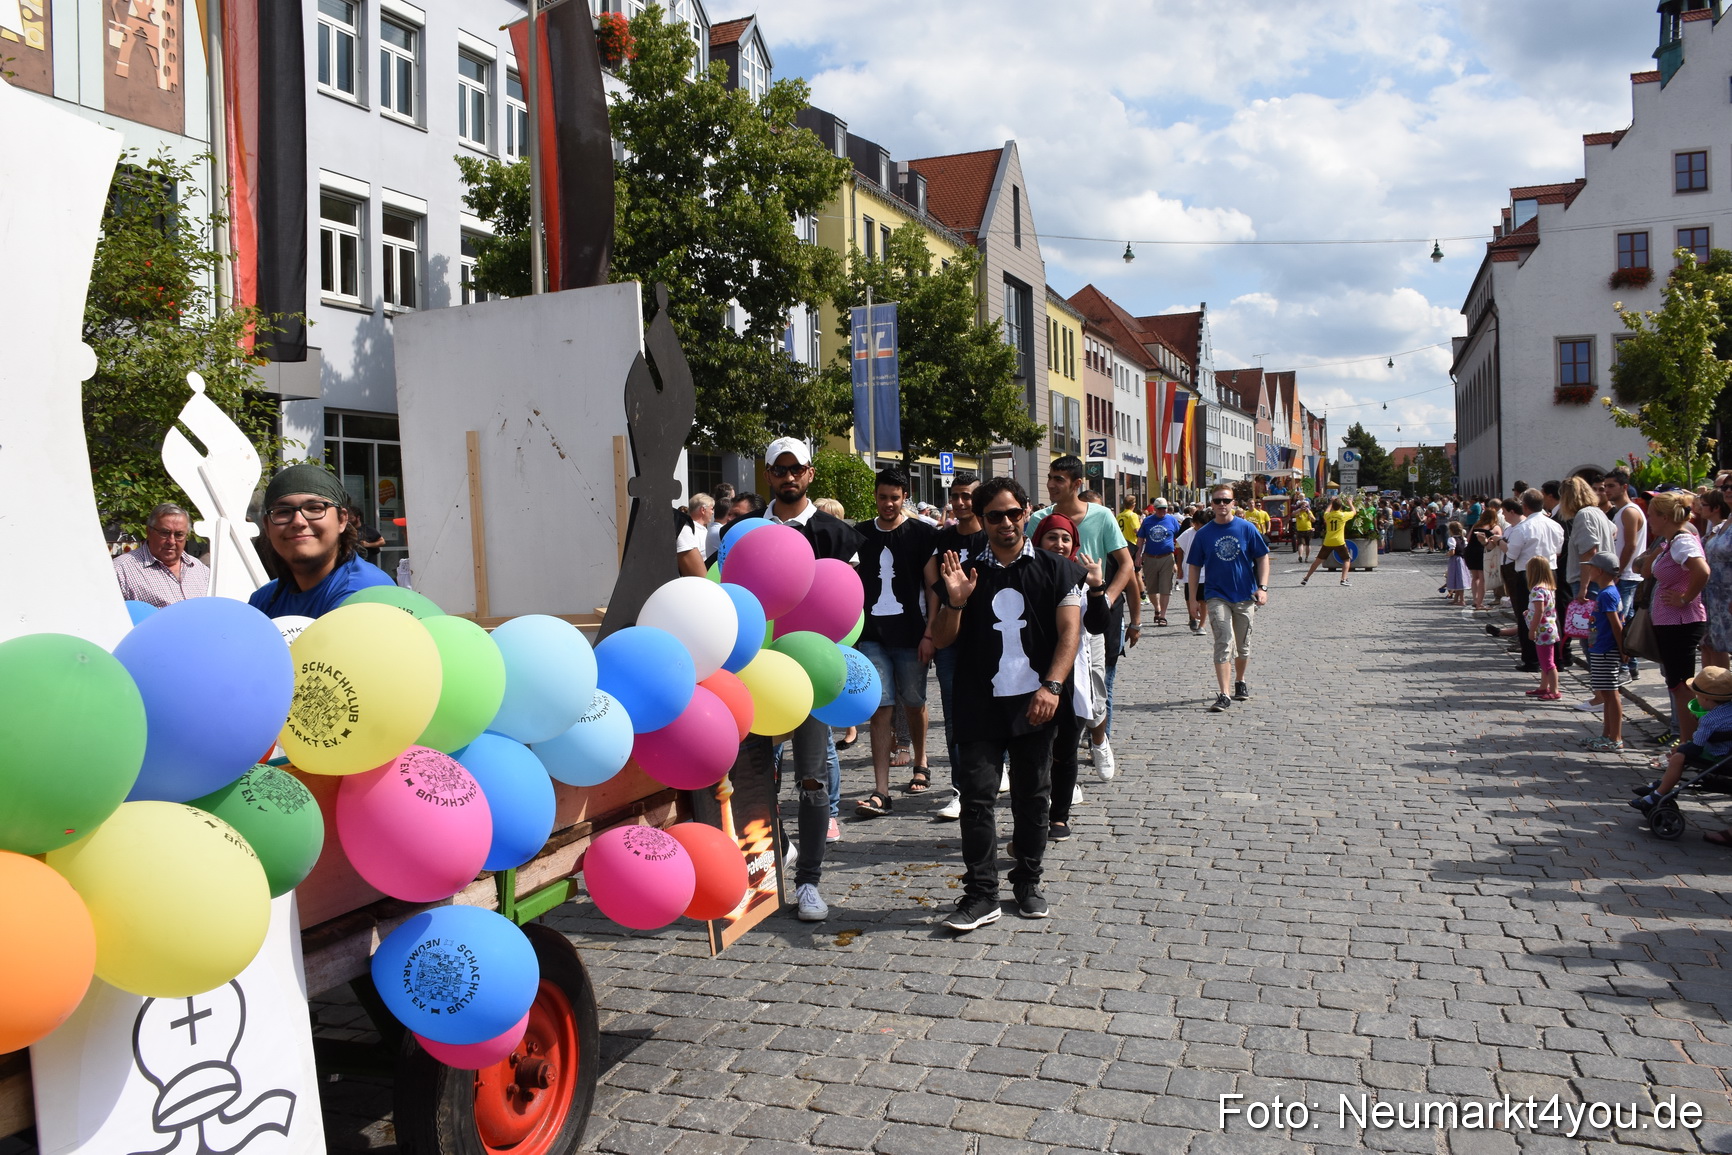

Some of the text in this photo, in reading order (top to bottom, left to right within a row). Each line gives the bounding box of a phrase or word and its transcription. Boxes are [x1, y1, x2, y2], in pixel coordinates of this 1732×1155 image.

[942, 455, 951, 472] P
[1329, 520, 1338, 531] 11
[301, 661, 360, 723] SCHACHKLUB
[577, 695, 610, 723] SCHACHKLU
[402, 937, 441, 995] NEUMARKT
[446, 943, 480, 1015] SCHACHKLUB
